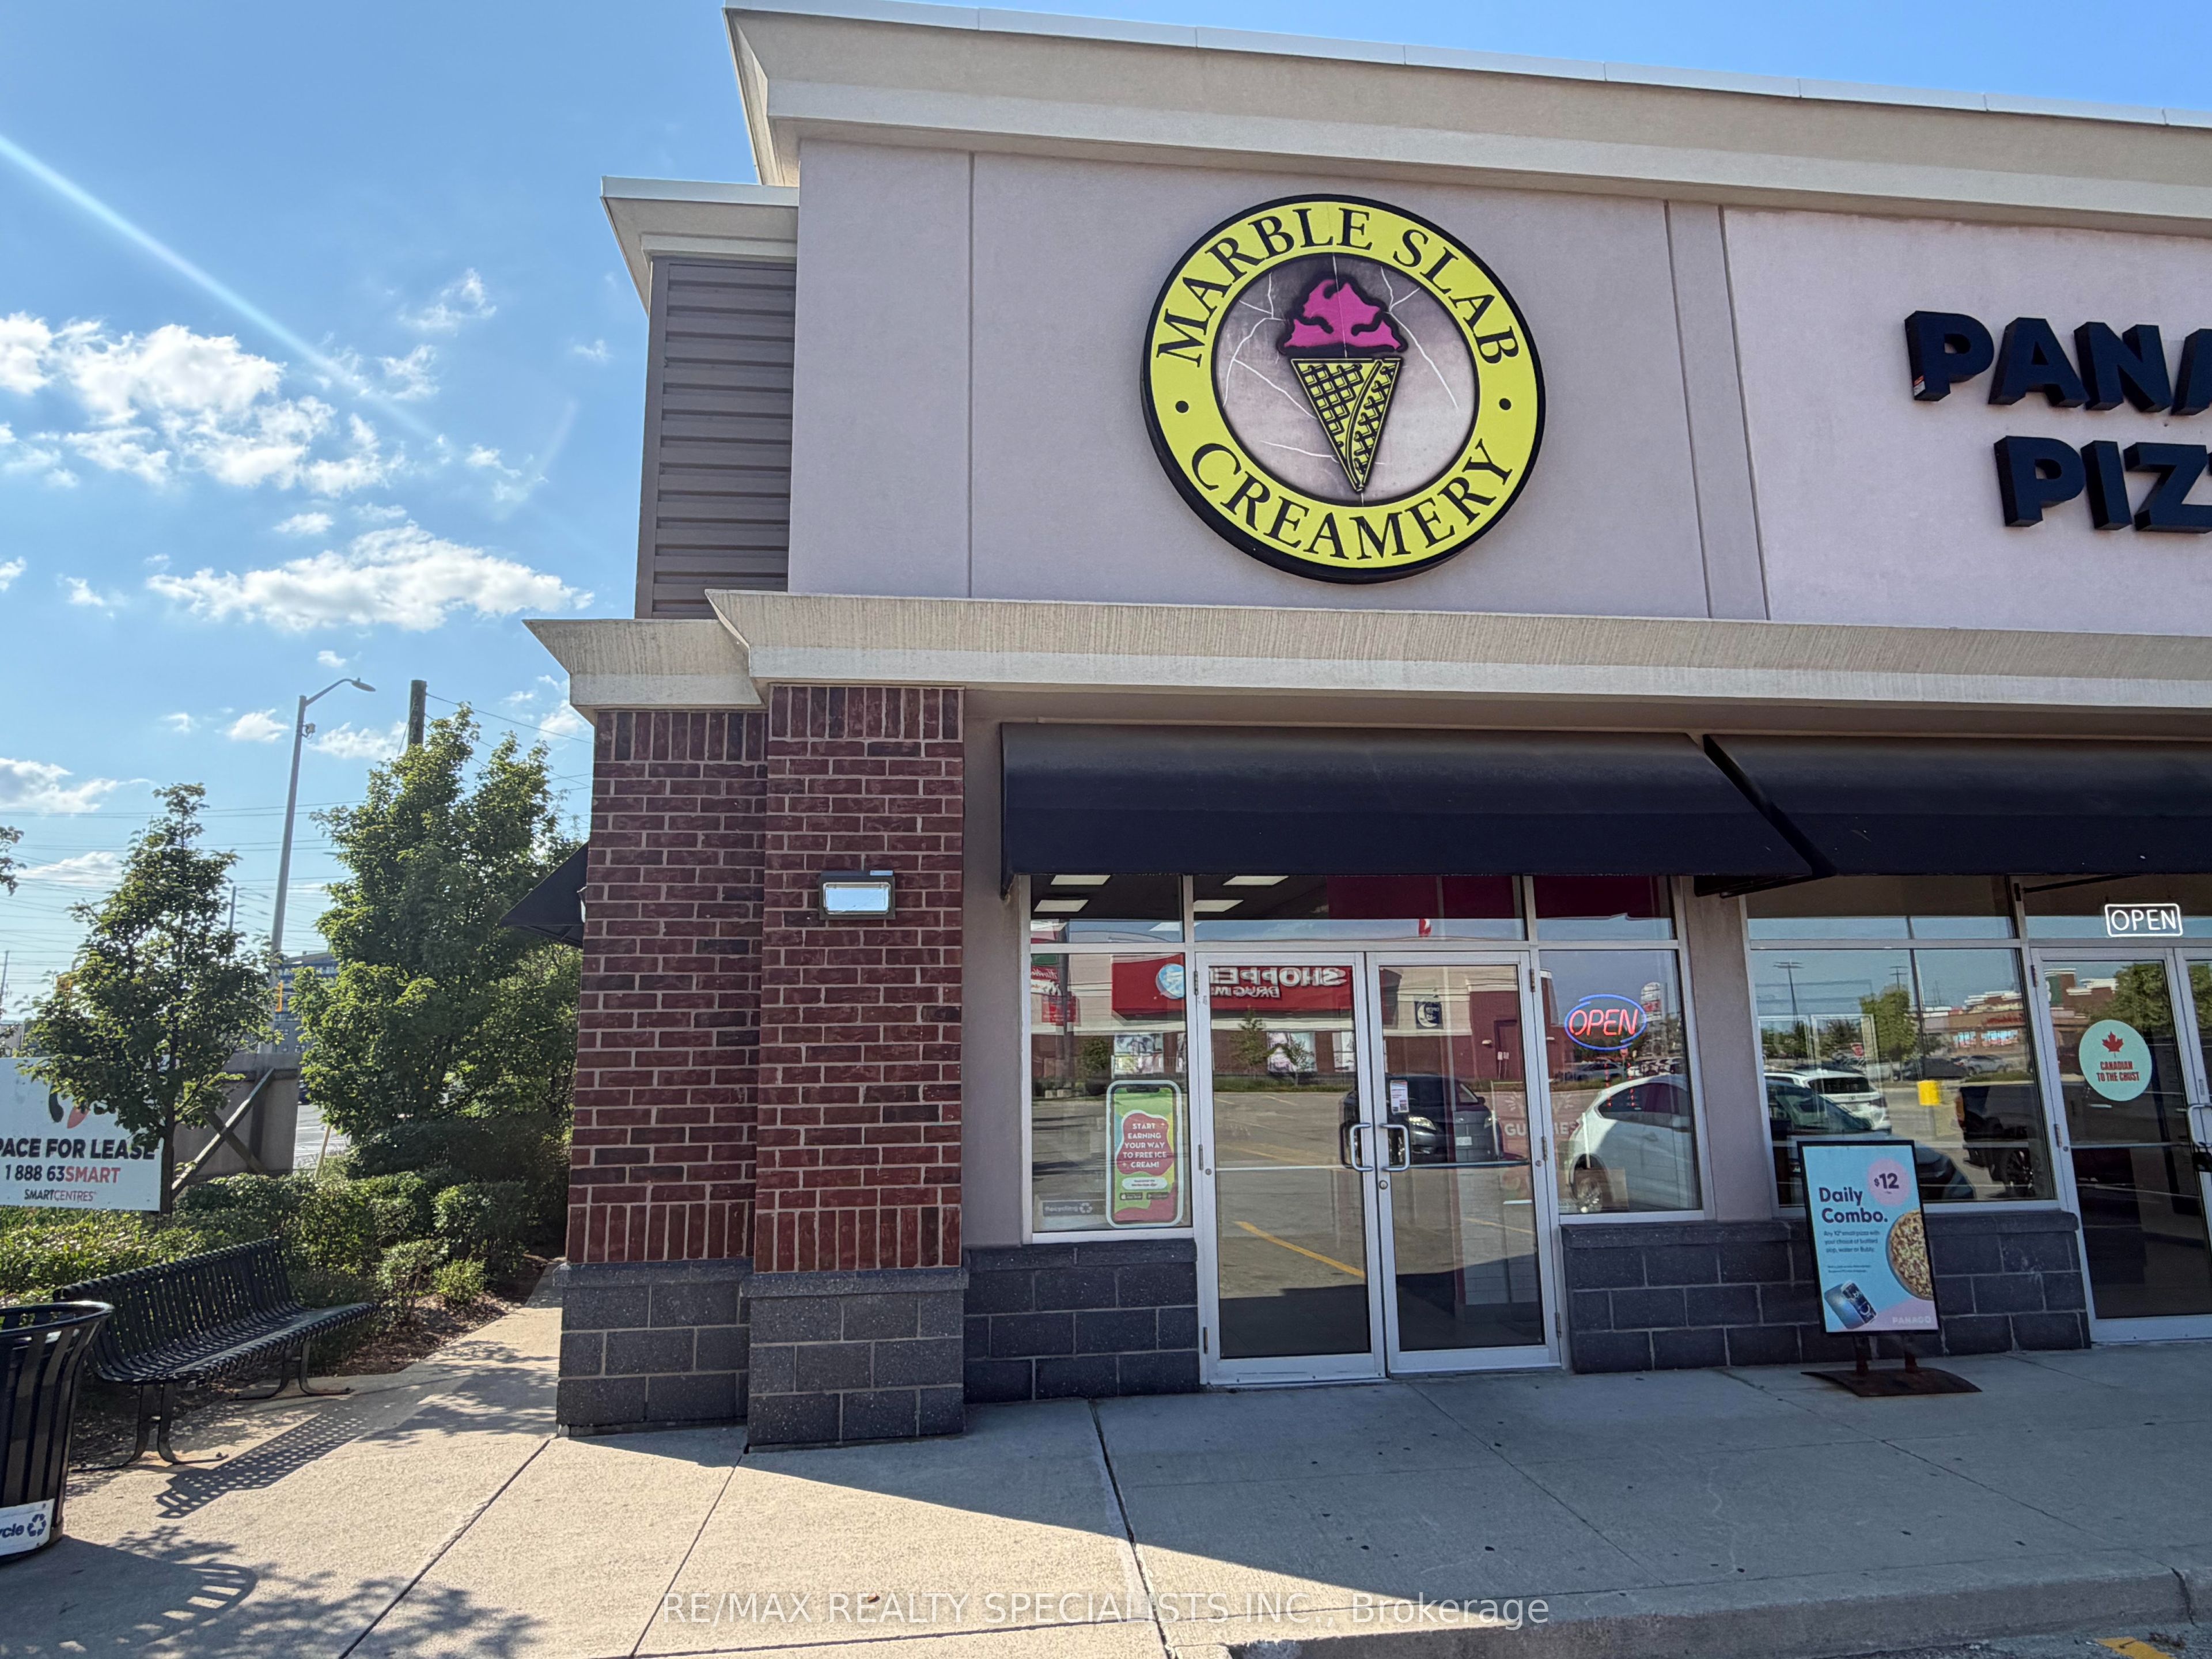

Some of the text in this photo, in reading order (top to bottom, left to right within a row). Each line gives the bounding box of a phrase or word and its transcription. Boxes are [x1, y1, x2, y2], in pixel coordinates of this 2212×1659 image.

[1156, 207, 1520, 368] MARBLE SLAB
[1994, 435, 2212, 534] PIZ
[1191, 438, 1514, 560] CREAMERY
[2111, 909, 2177, 931] OPEN
[1569, 1008, 1639, 1036] OPEN
[2100, 1061, 2133, 1070] CANADIAN
[2097, 1072, 2139, 1082] TO THE CRUST
[1504, 1122, 1578, 1137] GUIE
[45, 1138, 86, 1158] FOR
[5, 1164, 121, 1183] 1 888 63SMART
[1873, 1173, 1900, 1190] $12
[24, 1188, 94, 1202] SMARTCENTRES
[1819, 1187, 1863, 1206] Daily
[1821, 1207, 1888, 1224] Combo.
